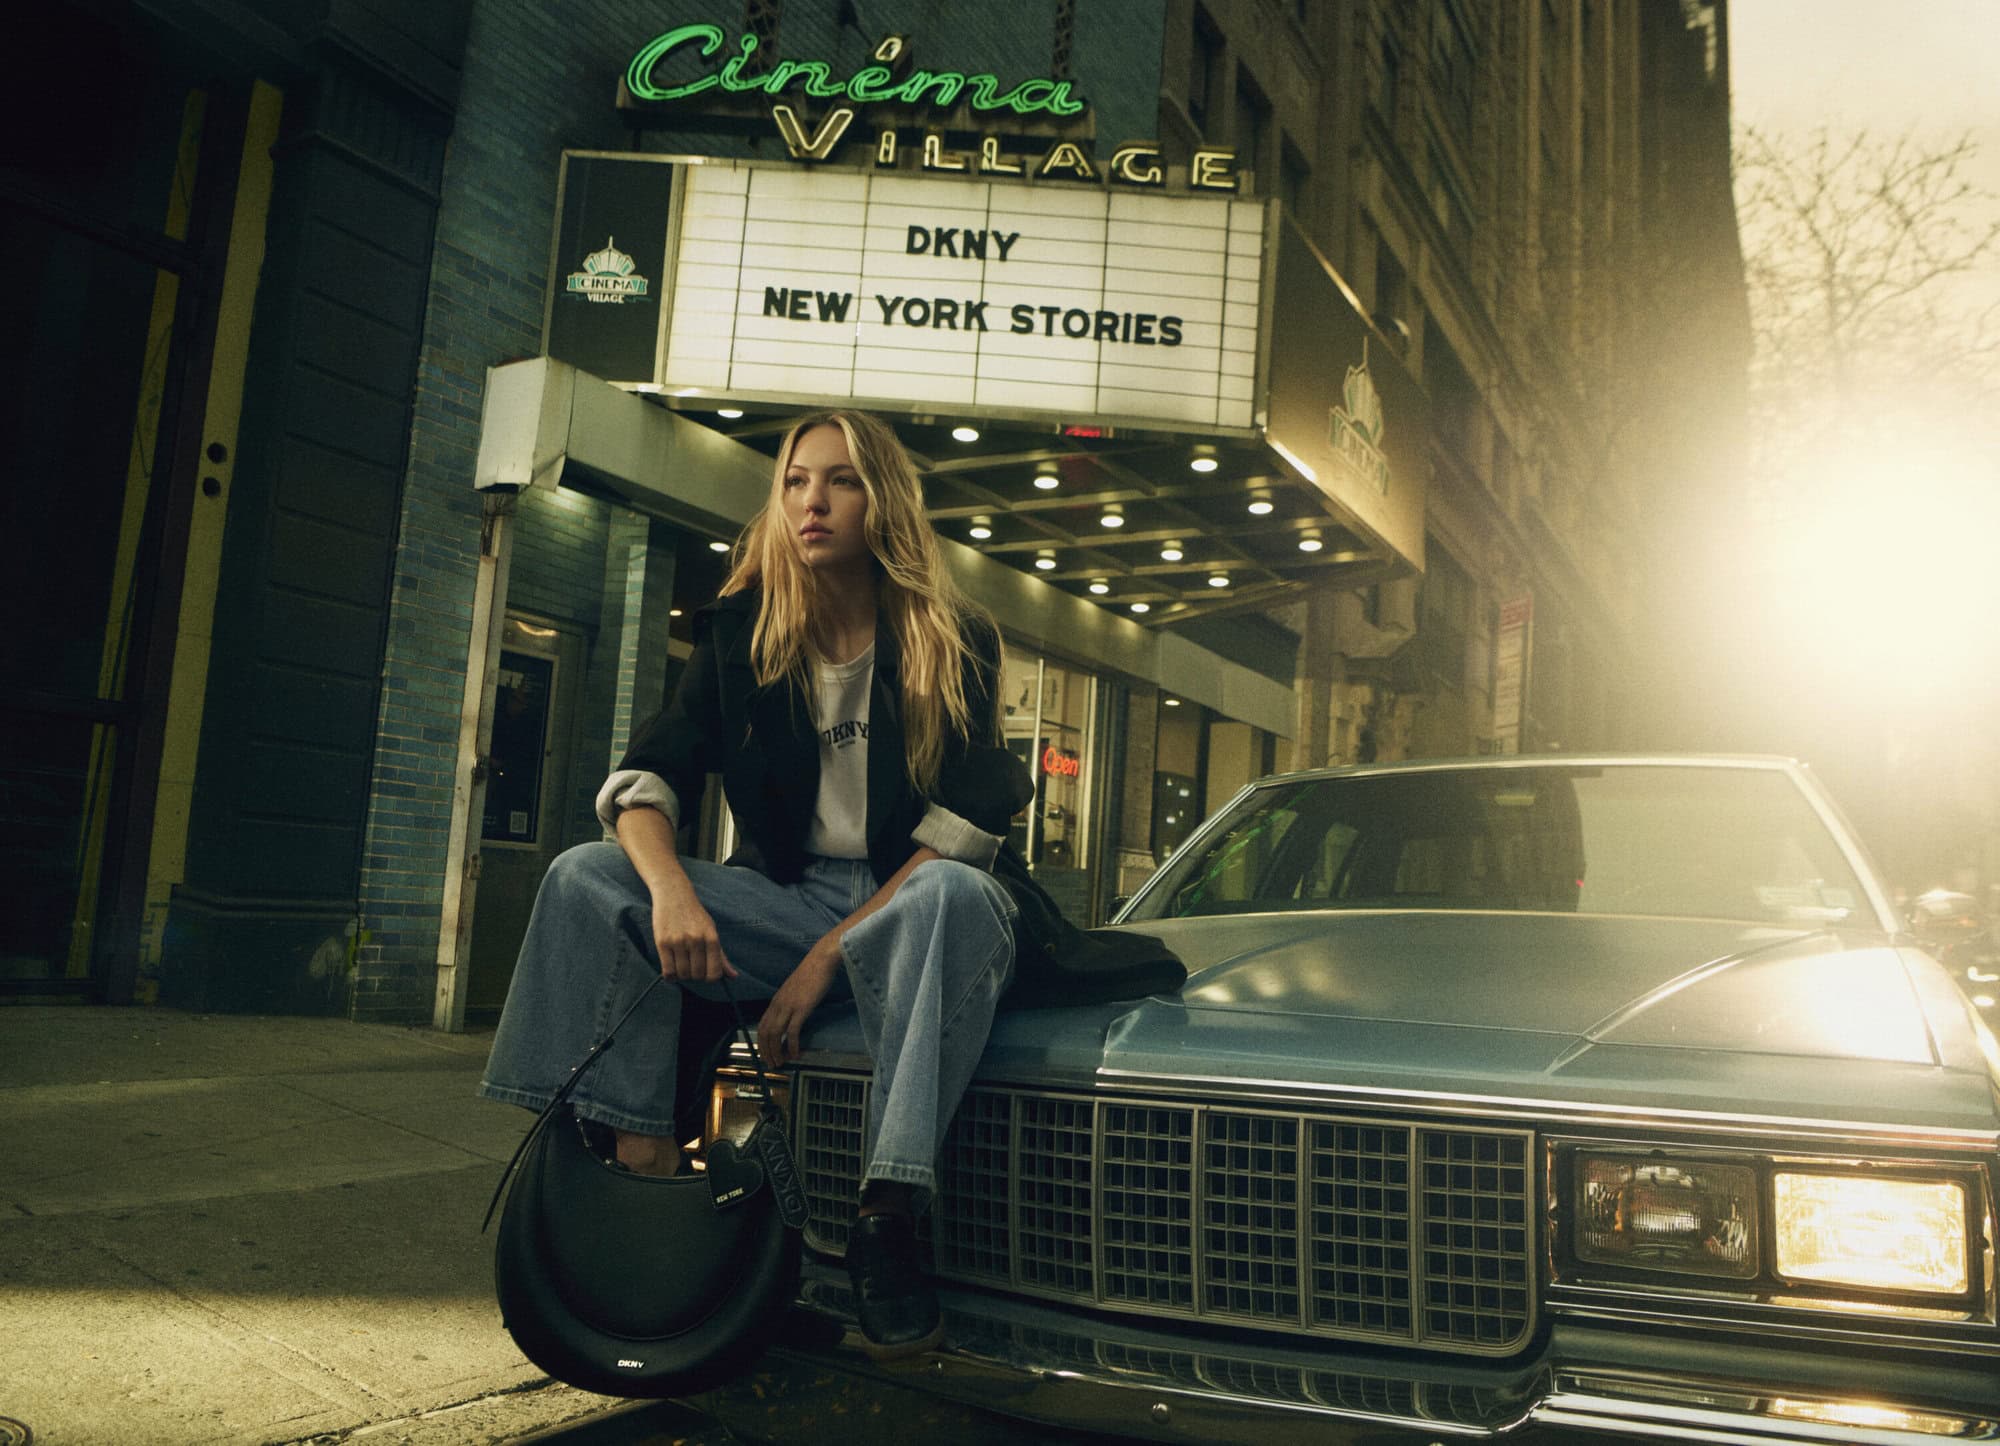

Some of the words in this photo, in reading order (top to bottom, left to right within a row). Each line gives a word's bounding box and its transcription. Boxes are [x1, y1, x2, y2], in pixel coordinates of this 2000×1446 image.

[773, 105, 1236, 188] VILLAGE
[906, 225, 1020, 262] DKNY
[581, 278, 634, 290] CINEMA
[587, 292, 625, 304] VILLAGE
[763, 286, 853, 323] NEW
[876, 294, 989, 332] YORK
[1011, 304, 1184, 347] STORIES
[1043, 747, 1079, 776] Open
[617, 1359, 644, 1369] DKNY
